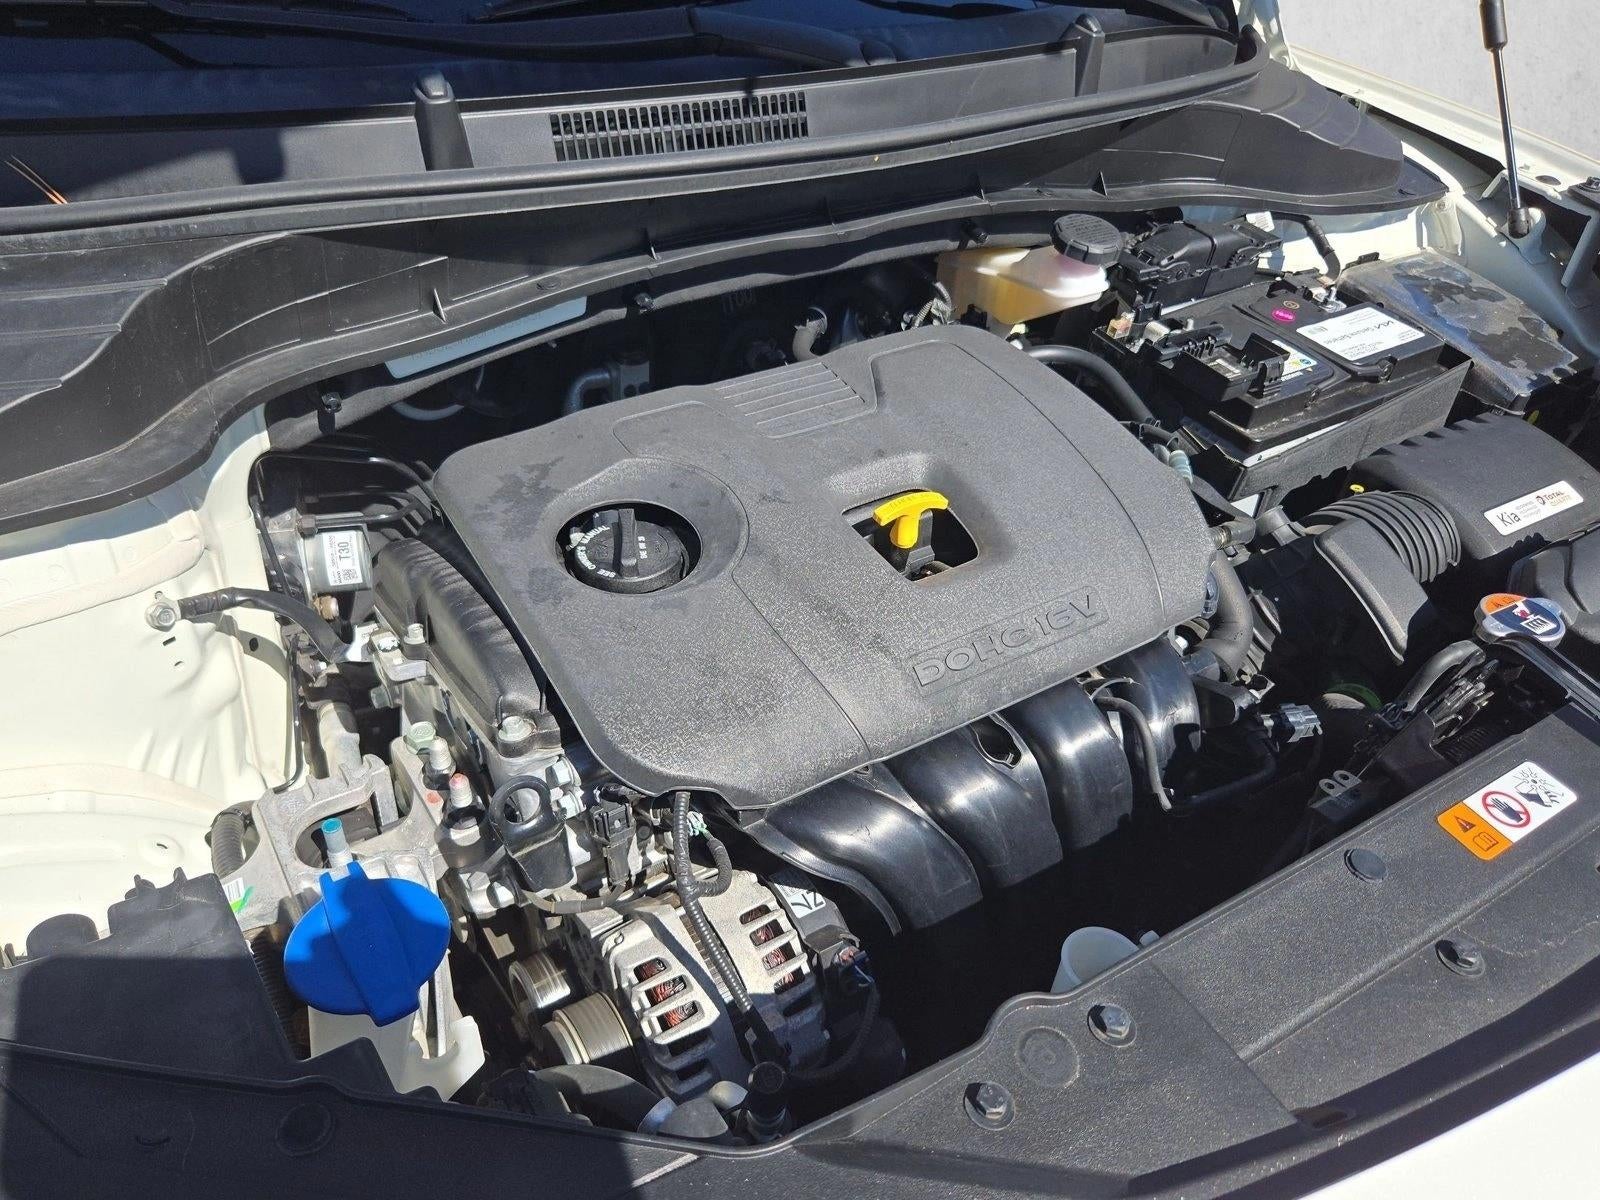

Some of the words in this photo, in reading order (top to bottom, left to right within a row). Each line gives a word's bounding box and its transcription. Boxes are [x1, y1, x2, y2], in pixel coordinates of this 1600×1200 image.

[1543, 490, 1565, 501] TOTAL
[1496, 511, 1521, 527] Kia
[580, 525, 610, 544] MANUAL
[597, 568, 616, 578] SEE
[1034, 594, 1097, 636] 16V
